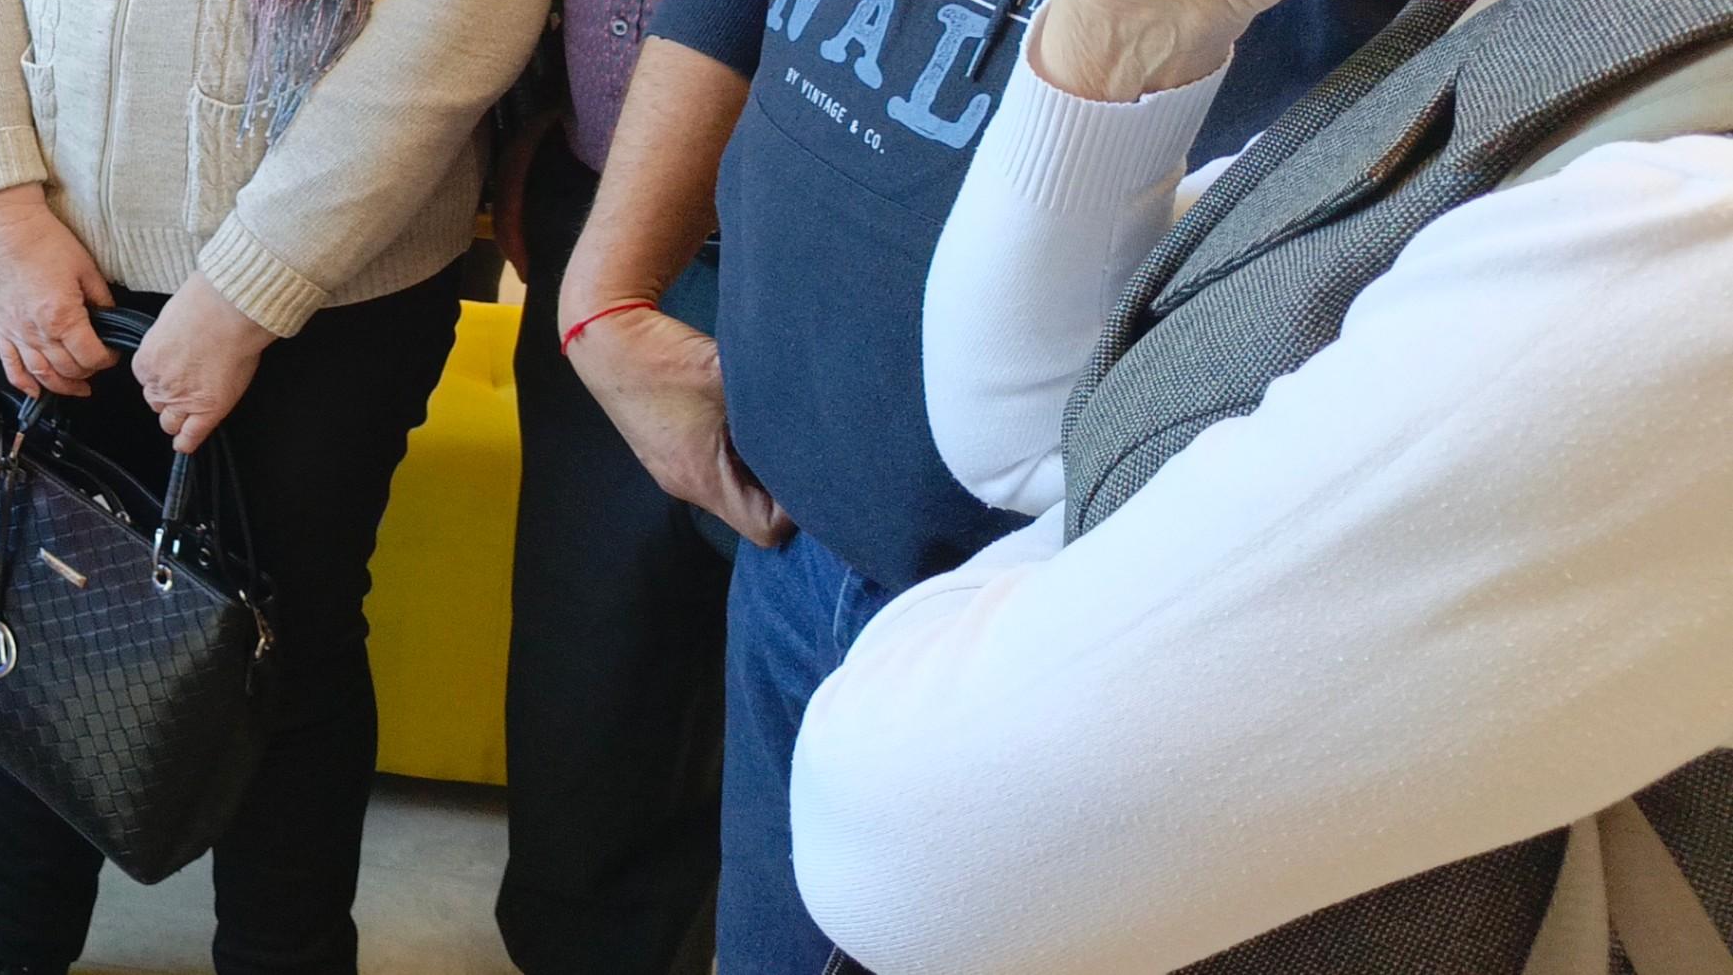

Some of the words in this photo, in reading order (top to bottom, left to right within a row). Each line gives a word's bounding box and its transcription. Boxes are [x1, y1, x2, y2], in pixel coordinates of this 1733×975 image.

[783, 67, 800, 83] BY
[801, 78, 848, 125] VINTAGE
[849, 118, 860, 134] &
[863, 127, 885, 155] CO.
